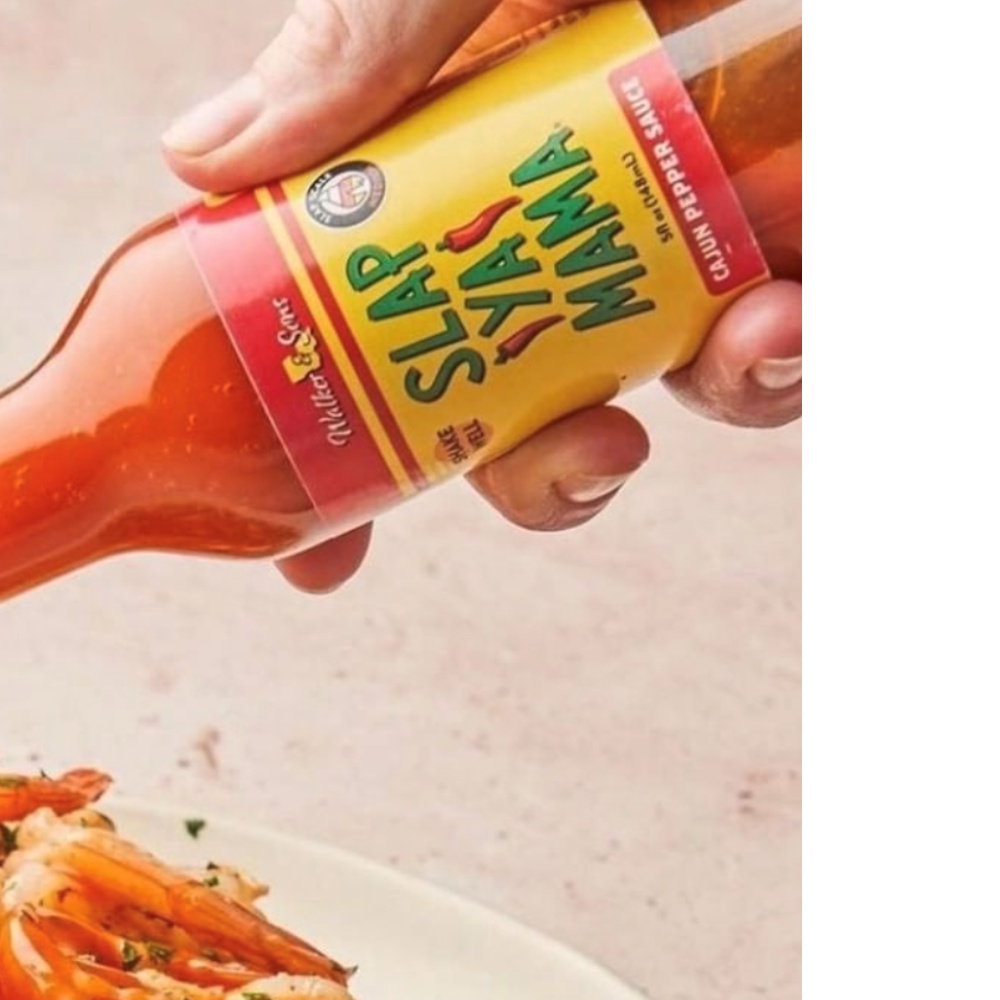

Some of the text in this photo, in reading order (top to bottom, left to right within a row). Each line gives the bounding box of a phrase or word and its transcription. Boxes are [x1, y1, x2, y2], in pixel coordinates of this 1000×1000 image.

[509, 126, 657, 332] MAMA
[620, 76, 731, 282] CAJUN PEPPER SAUCE
[345, 242, 487, 404] SLAP
[457, 232, 553, 338] YA
[272, 297, 352, 446] Walker & Sons
[437, 425, 468, 464] SHAKE
